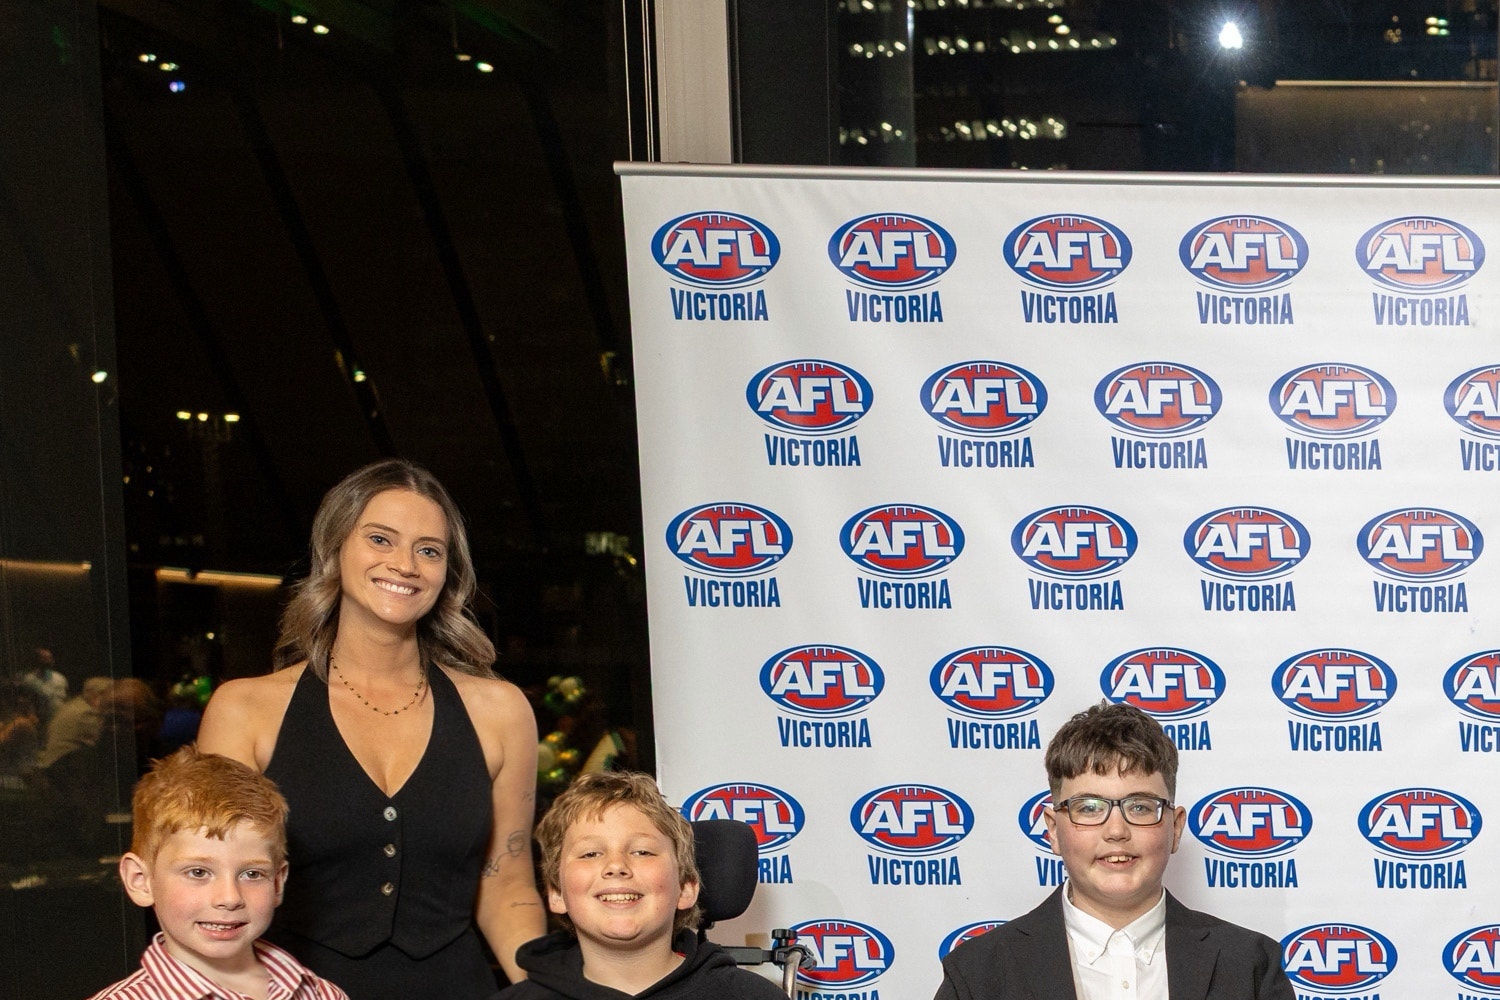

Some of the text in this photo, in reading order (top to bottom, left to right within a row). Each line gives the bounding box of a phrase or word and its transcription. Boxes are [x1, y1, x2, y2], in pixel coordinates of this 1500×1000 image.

[662, 230, 771, 266] AFL
[839, 232, 946, 268] AFL
[1014, 233, 1122, 269] AFL
[1190, 234, 1298, 270] AFL
[1367, 235, 1475, 271] AFL
[670, 288, 768, 320] VICTORIA
[847, 291, 943, 323] VICTORIA
[1021, 292, 1117, 323] VICTORIA
[1197, 293, 1292, 324] VICTORIA
[1374, 293, 1469, 326] VICTORIA
[757, 377, 863, 413] AFL
[931, 378, 1038, 414] AFL
[1105, 380, 1212, 415] AFL
[1280, 381, 1387, 416] AFL
[765, 434, 860, 466] VICTORIA
[938, 436, 1034, 467] VICTORIA
[1112, 437, 1207, 468] VICTORIA
[1286, 439, 1381, 469] VICTORIA
[677, 520, 783, 555] AFL
[850, 522, 955, 557] AFL
[1022, 523, 1128, 558] AFL
[1195, 524, 1301, 559] AFL
[1368, 526, 1474, 560] AFL
[684, 576, 780, 607] VICTORIA
[858, 578, 951, 609] VICTORIA
[1029, 579, 1123, 610] VICTORIA
[1201, 580, 1295, 611] VICTORIA
[1374, 581, 1467, 612] VICTORIA
[770, 662, 875, 696] AFL
[940, 664, 1044, 698] AFL
[1111, 665, 1216, 699] AFL
[1282, 666, 1387, 700] AFL
[778, 717, 871, 748] VICTORIA
[947, 718, 1040, 749] VICTORIA
[1288, 720, 1382, 751] VICTORIA
[861, 801, 965, 834] AFL
[1199, 804, 1304, 837] AFL
[1369, 805, 1473, 838] AFL
[868, 855, 961, 885] VICTORIA
[1205, 857, 1298, 888] VICTORIA
[1374, 858, 1466, 889] VICTORIA
[1285, 939, 1389, 972] AFL
